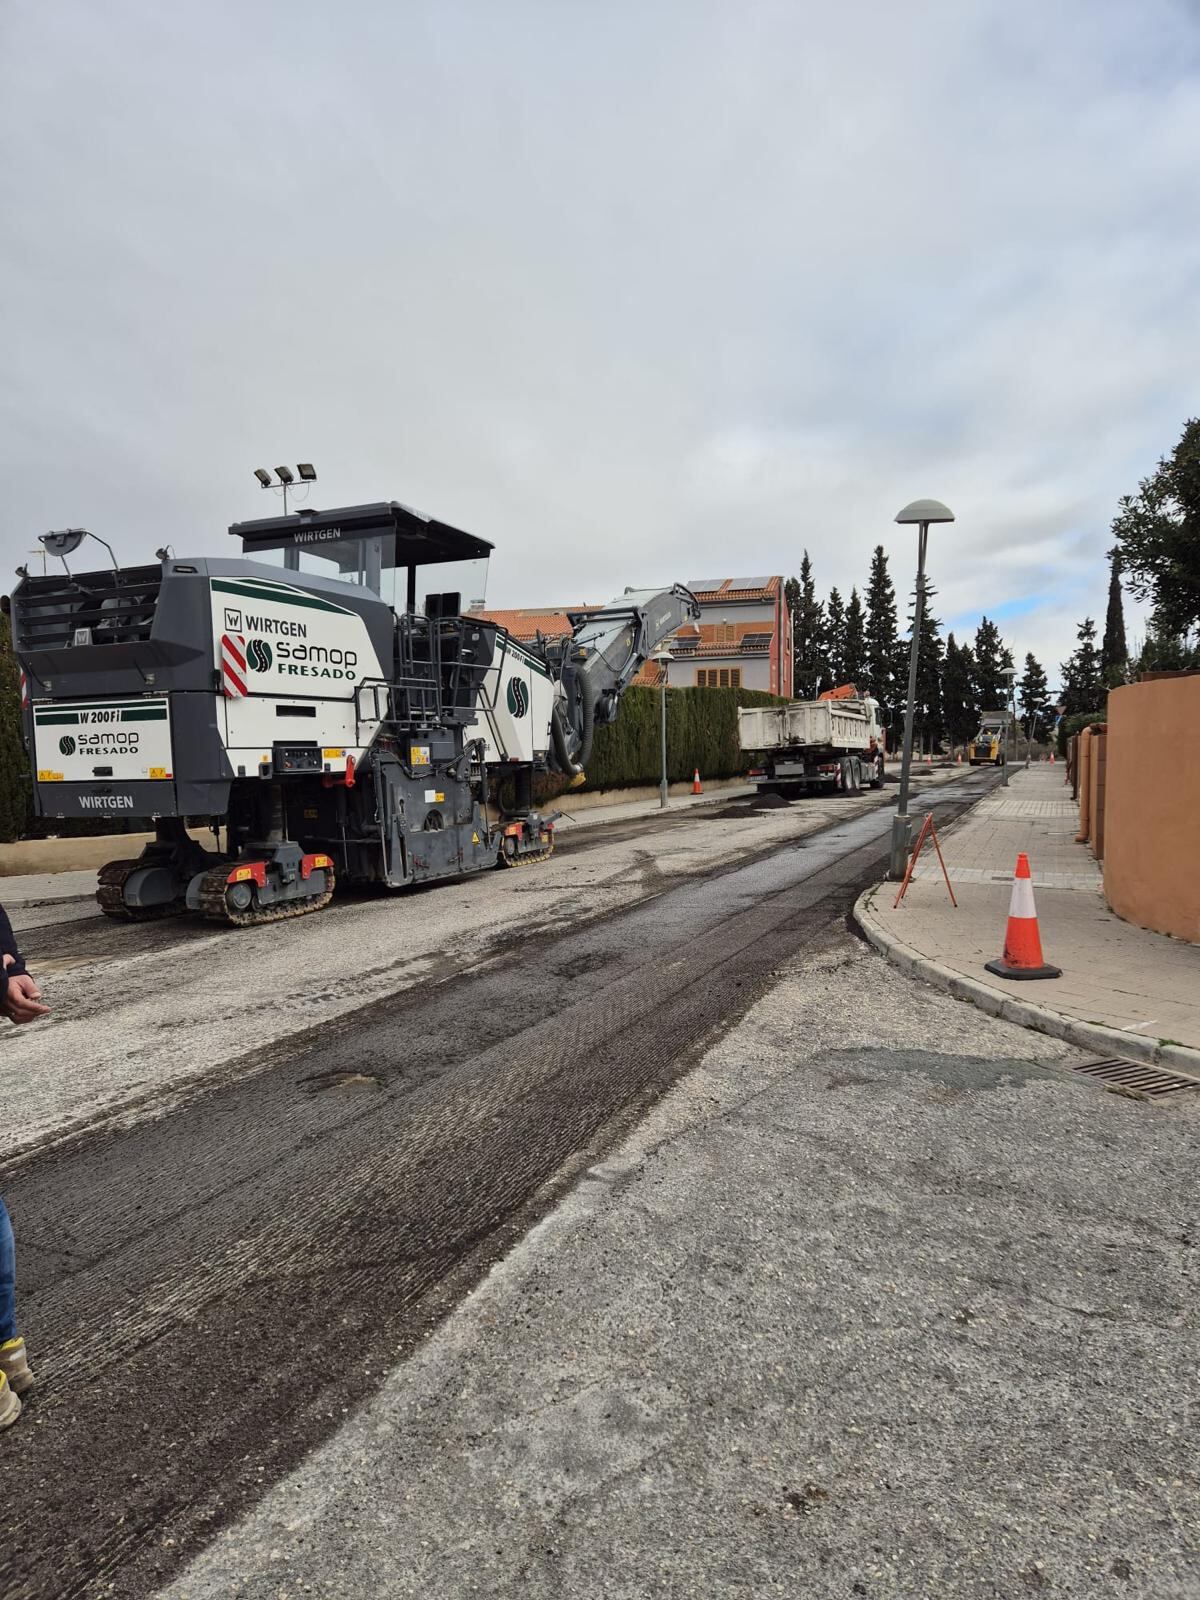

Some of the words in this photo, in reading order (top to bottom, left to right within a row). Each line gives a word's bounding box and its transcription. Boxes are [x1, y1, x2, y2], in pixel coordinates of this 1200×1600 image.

[294, 527, 341, 543] WIRTGEN
[245, 615, 307, 638] WIRTGEN
[277, 663, 356, 681] FRESADO
[80, 712, 89, 724] W
[79, 746, 139, 755] FRESADO
[79, 795, 134, 809] WIRTGEN
